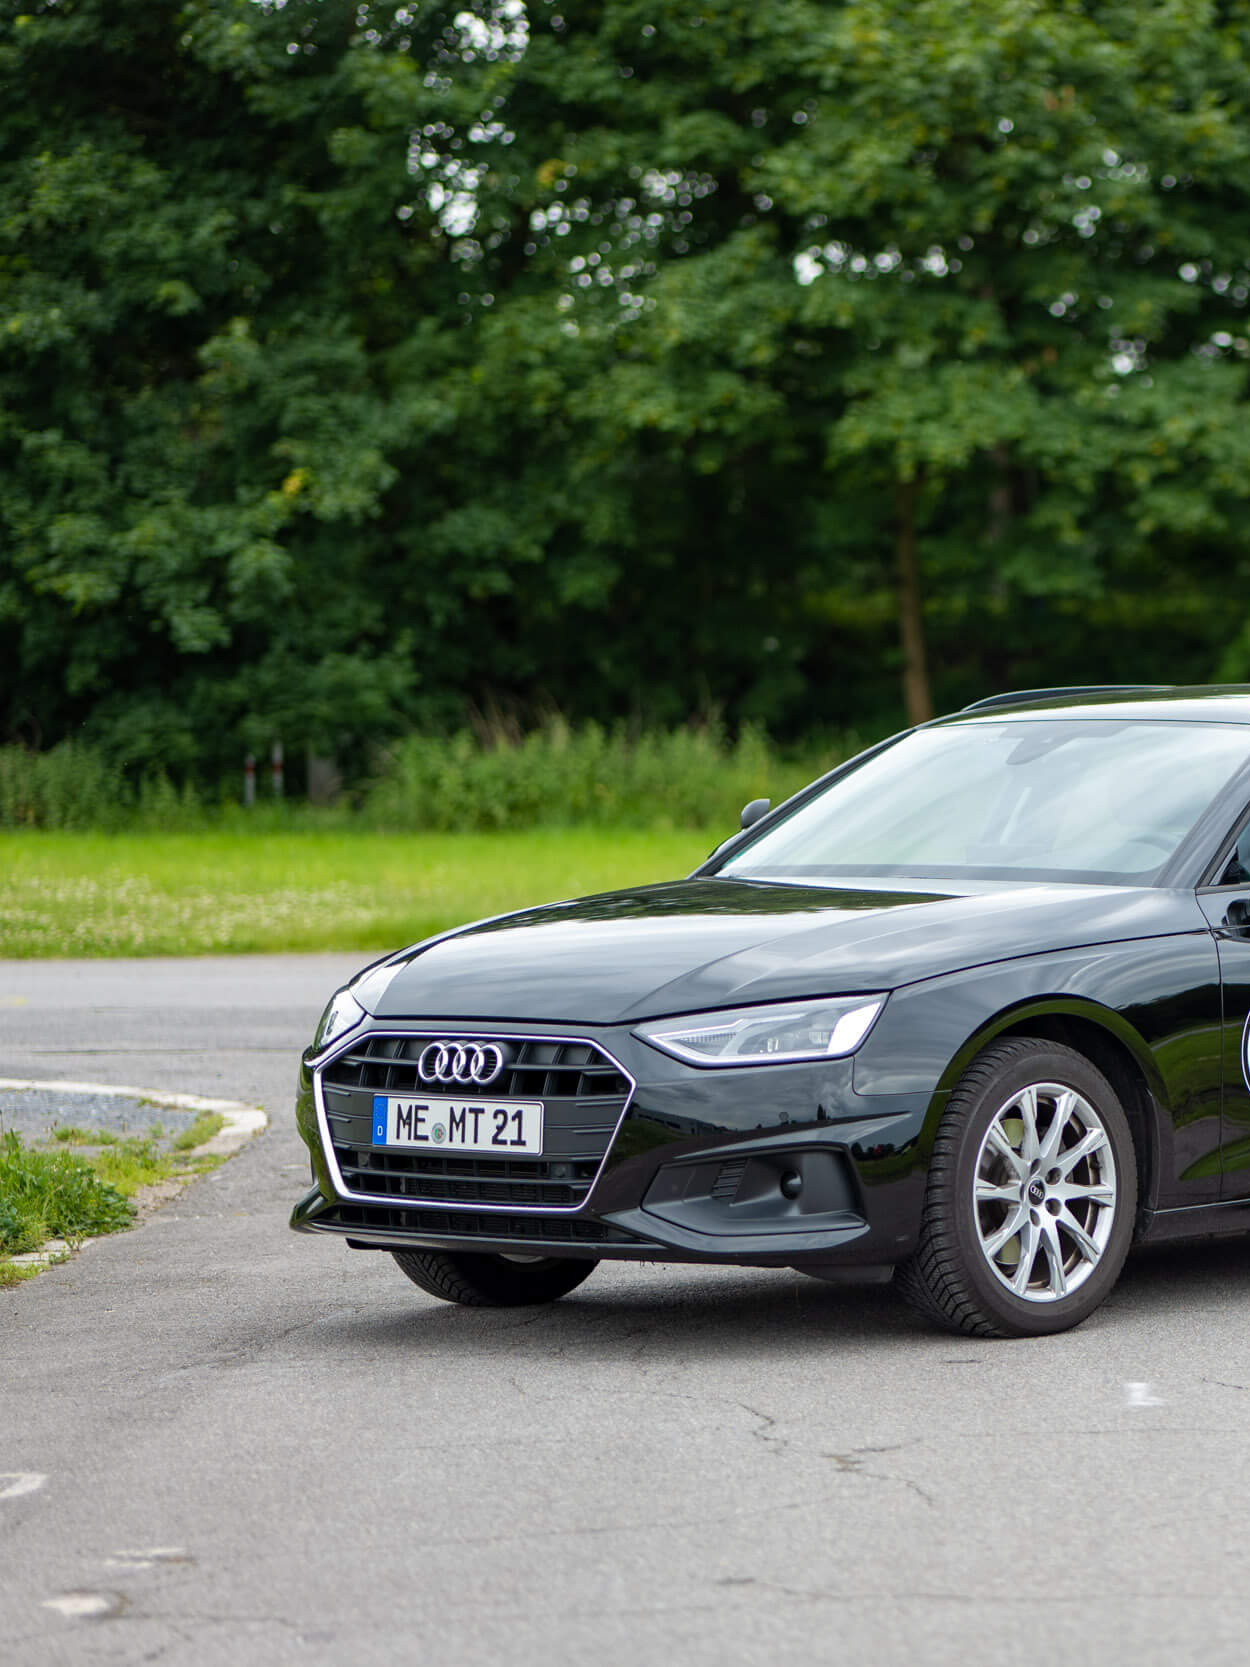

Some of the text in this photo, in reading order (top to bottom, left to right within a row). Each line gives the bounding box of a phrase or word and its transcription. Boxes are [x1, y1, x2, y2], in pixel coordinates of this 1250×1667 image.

[376, 1125, 383, 1136] D
[396, 1104, 527, 1146] ME MT 21
